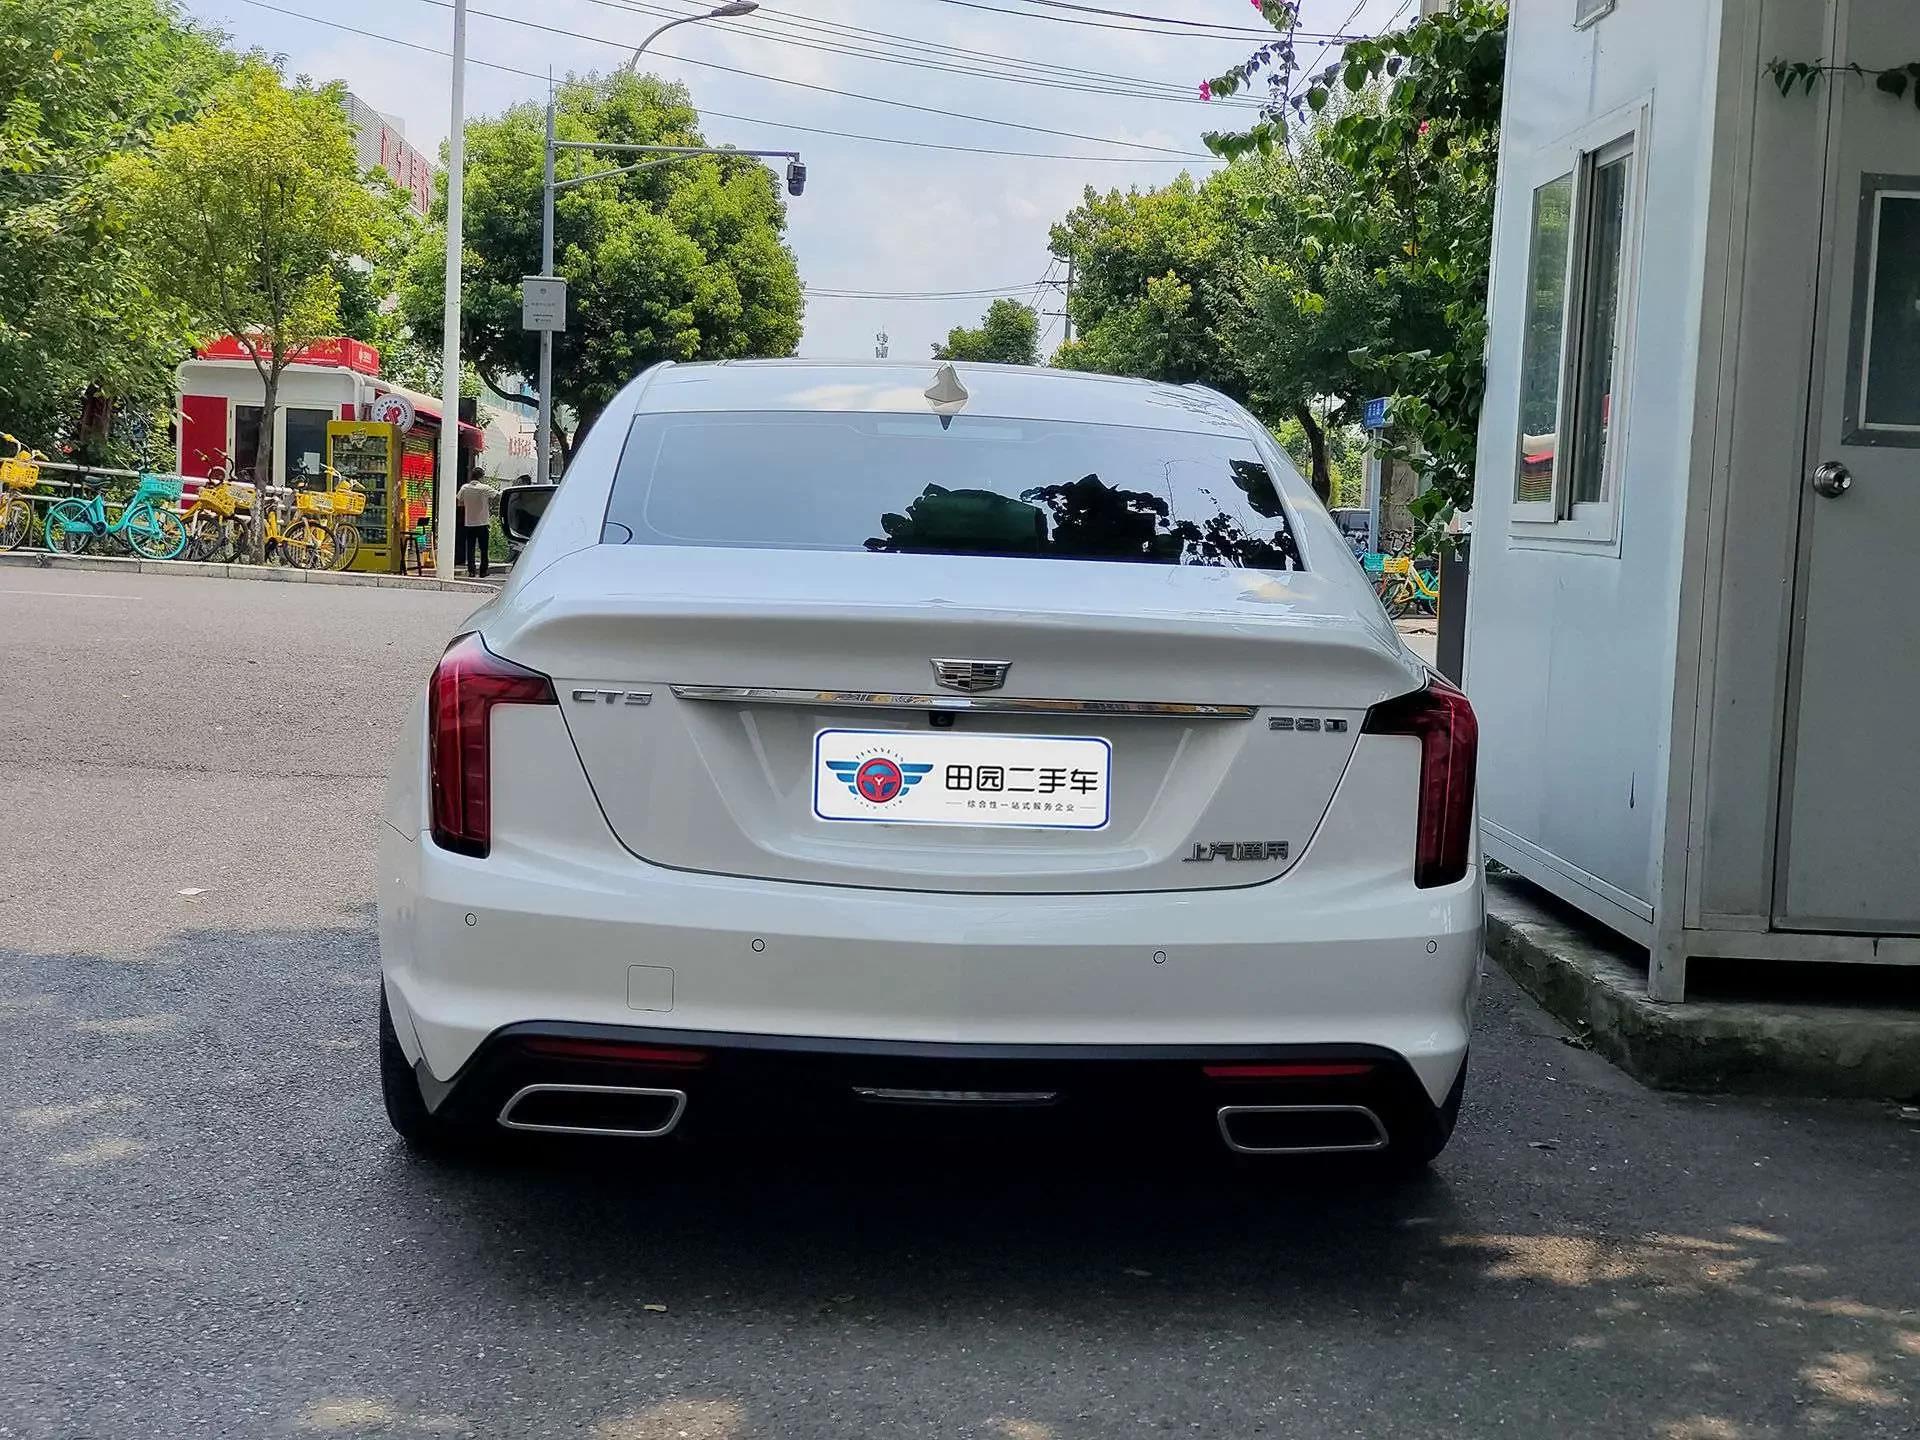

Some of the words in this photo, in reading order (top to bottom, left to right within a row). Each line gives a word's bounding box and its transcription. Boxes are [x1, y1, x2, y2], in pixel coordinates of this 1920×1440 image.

[945, 764, 1099, 795] 田园二手车
[966, 800, 1076, 813] 综合性一站式服务企业
[1182, 840, 1289, 861] 上汽通用
